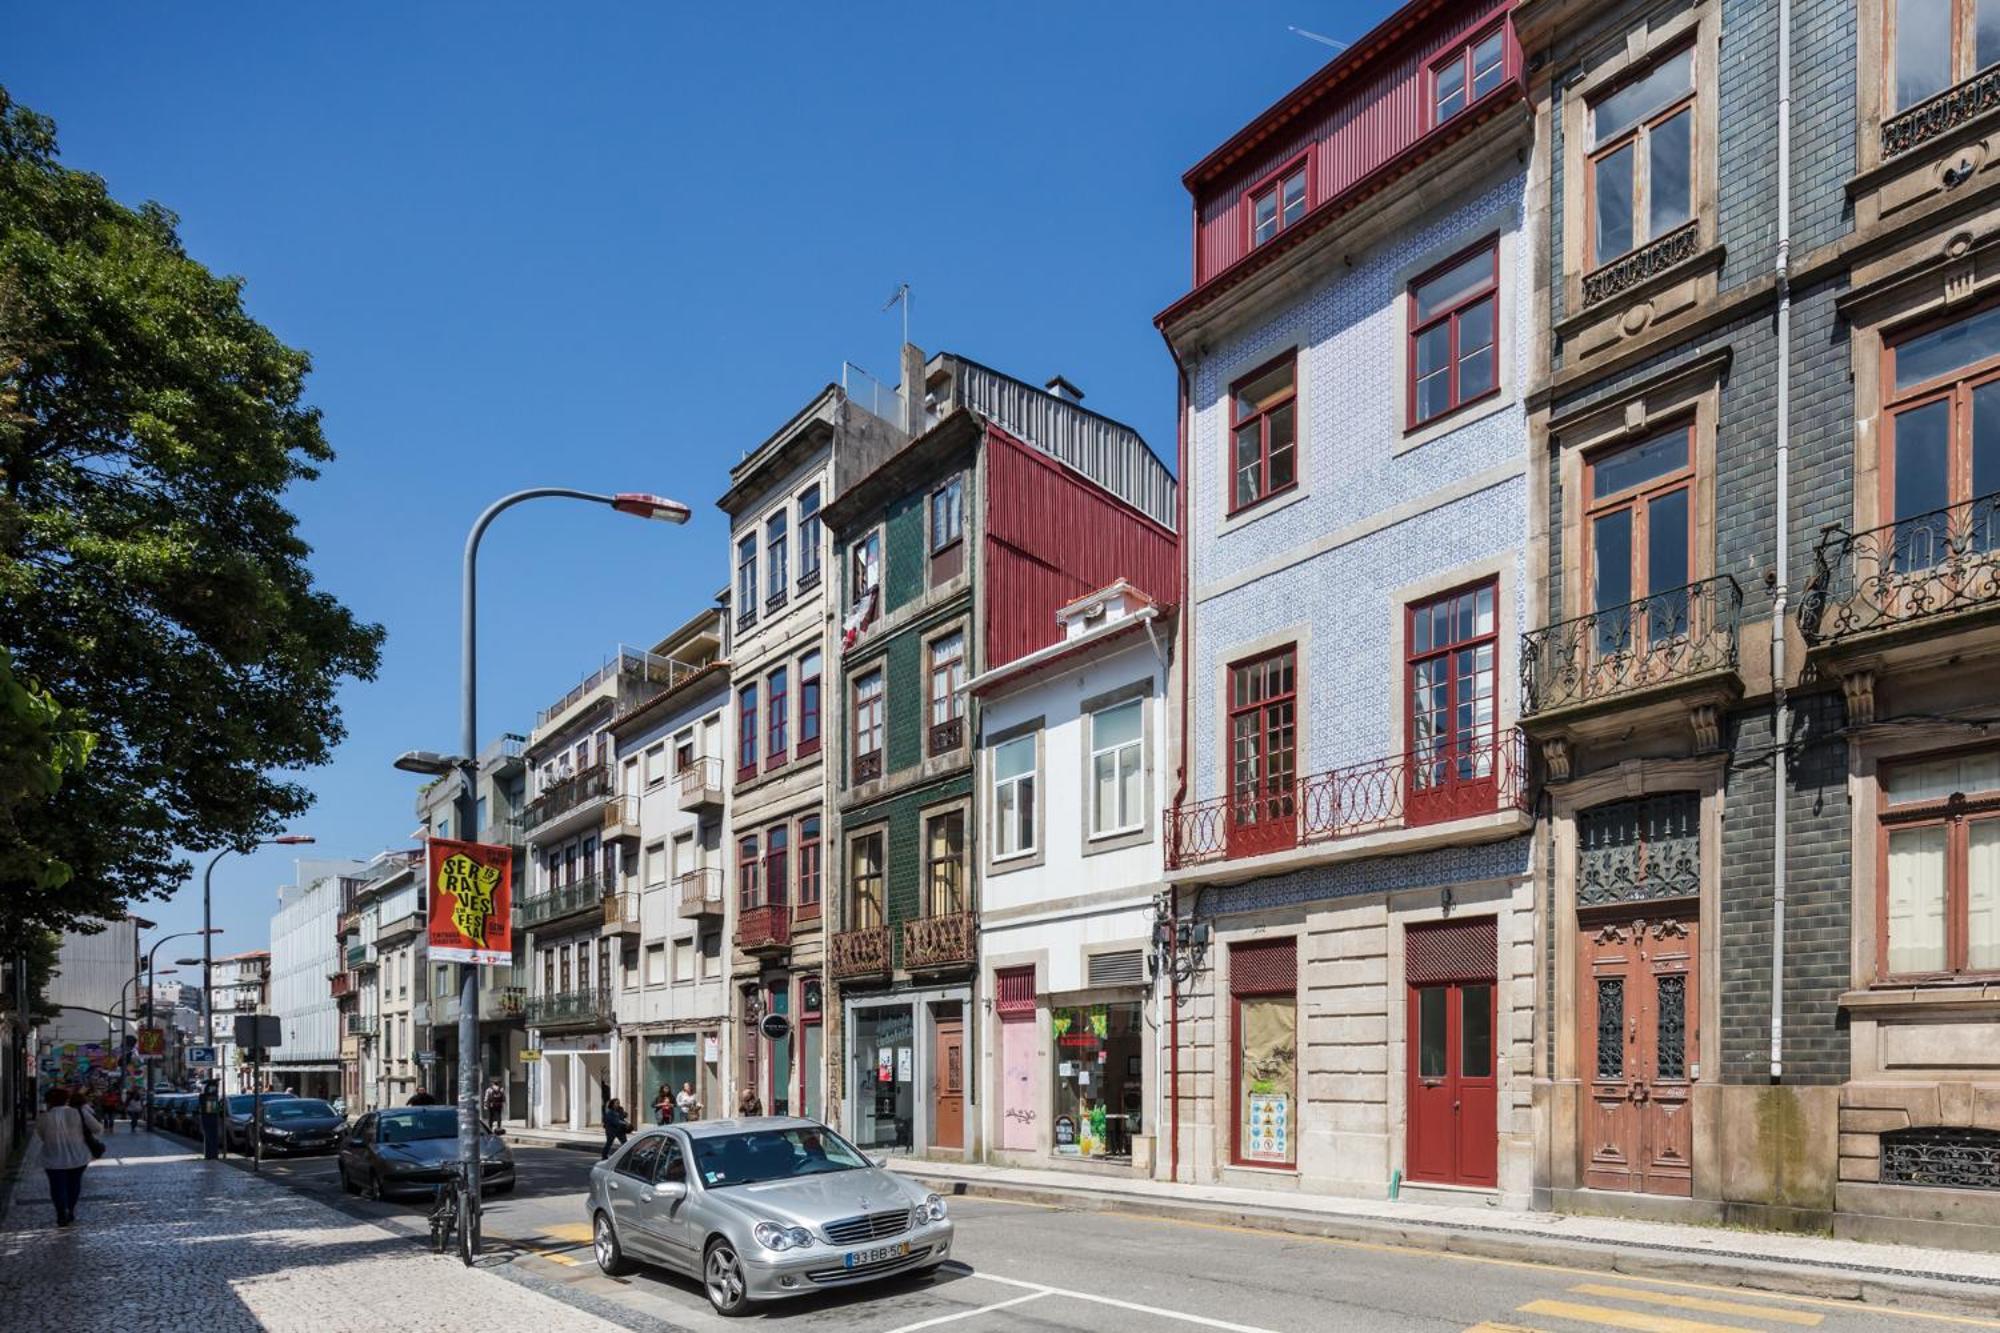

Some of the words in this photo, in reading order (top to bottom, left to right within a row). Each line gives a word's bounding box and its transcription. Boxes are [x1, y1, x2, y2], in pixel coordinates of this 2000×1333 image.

[444, 859, 479, 880] SER
[484, 868, 495, 878] 15
[446, 875, 484, 897] RAL
[458, 893, 490, 913] VES
[458, 913, 481, 927] FES
[464, 926, 480, 939] TA
[193, 1050, 204, 1060] P
